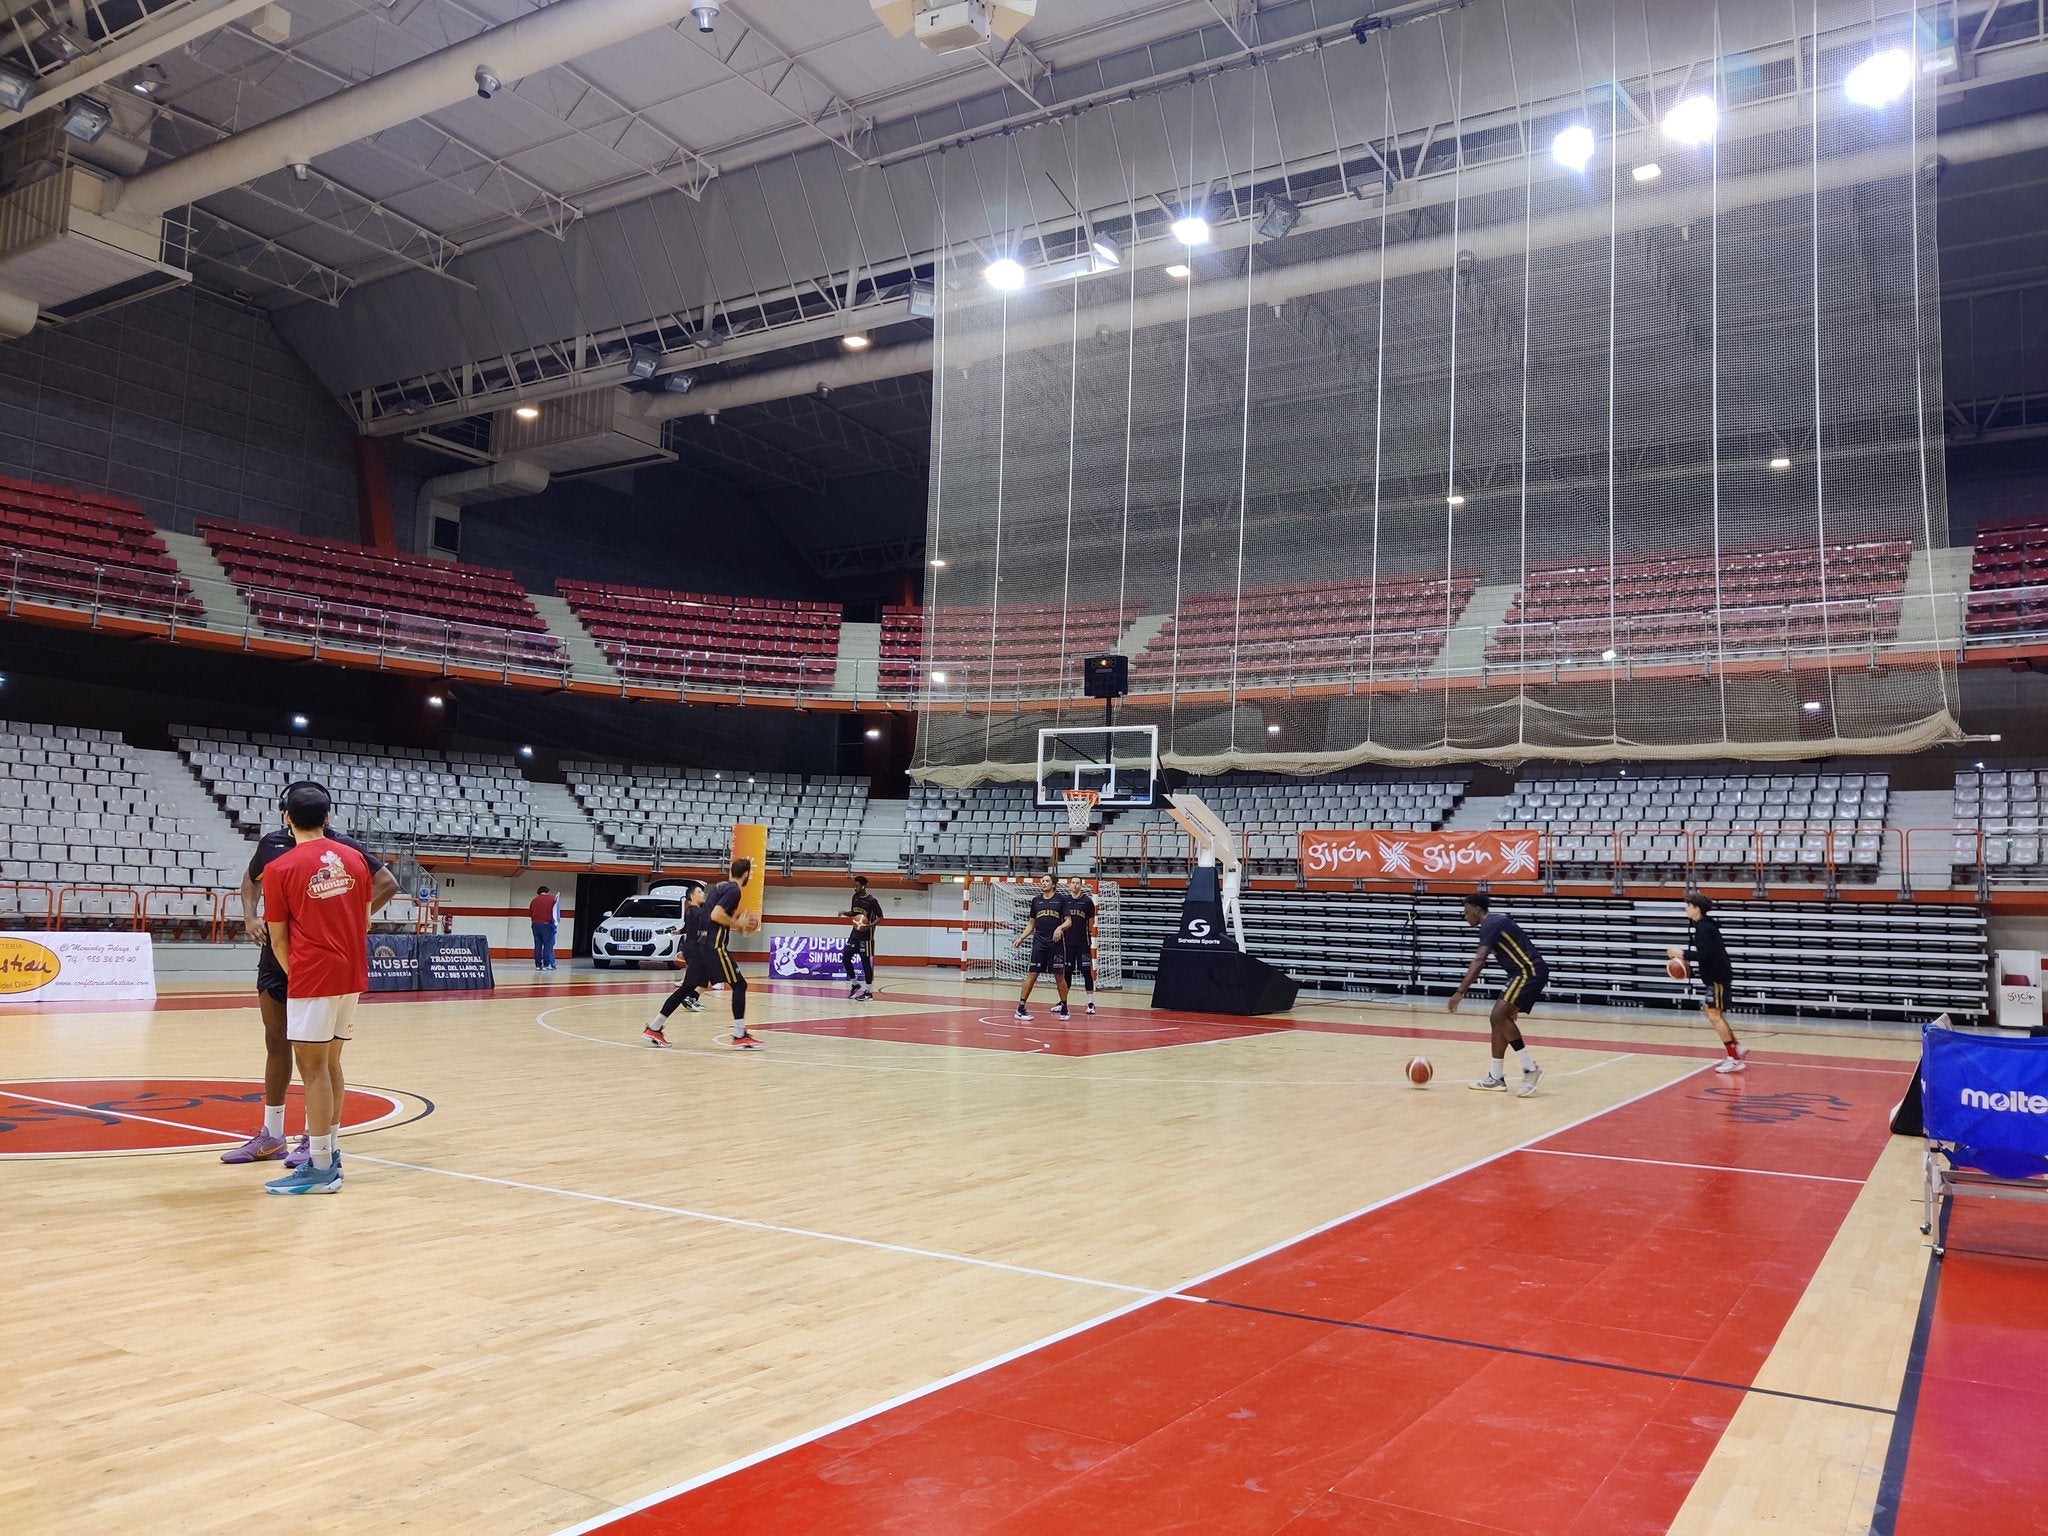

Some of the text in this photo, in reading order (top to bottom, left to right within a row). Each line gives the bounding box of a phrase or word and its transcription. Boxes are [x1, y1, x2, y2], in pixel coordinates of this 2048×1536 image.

[1308, 840, 1371, 871] gijón
[1423, 841, 1492, 873] gijón
[311, 877, 350, 893] Manzer
[373, 960, 418, 969] MUSEO
[809, 953, 823, 963] SIN
